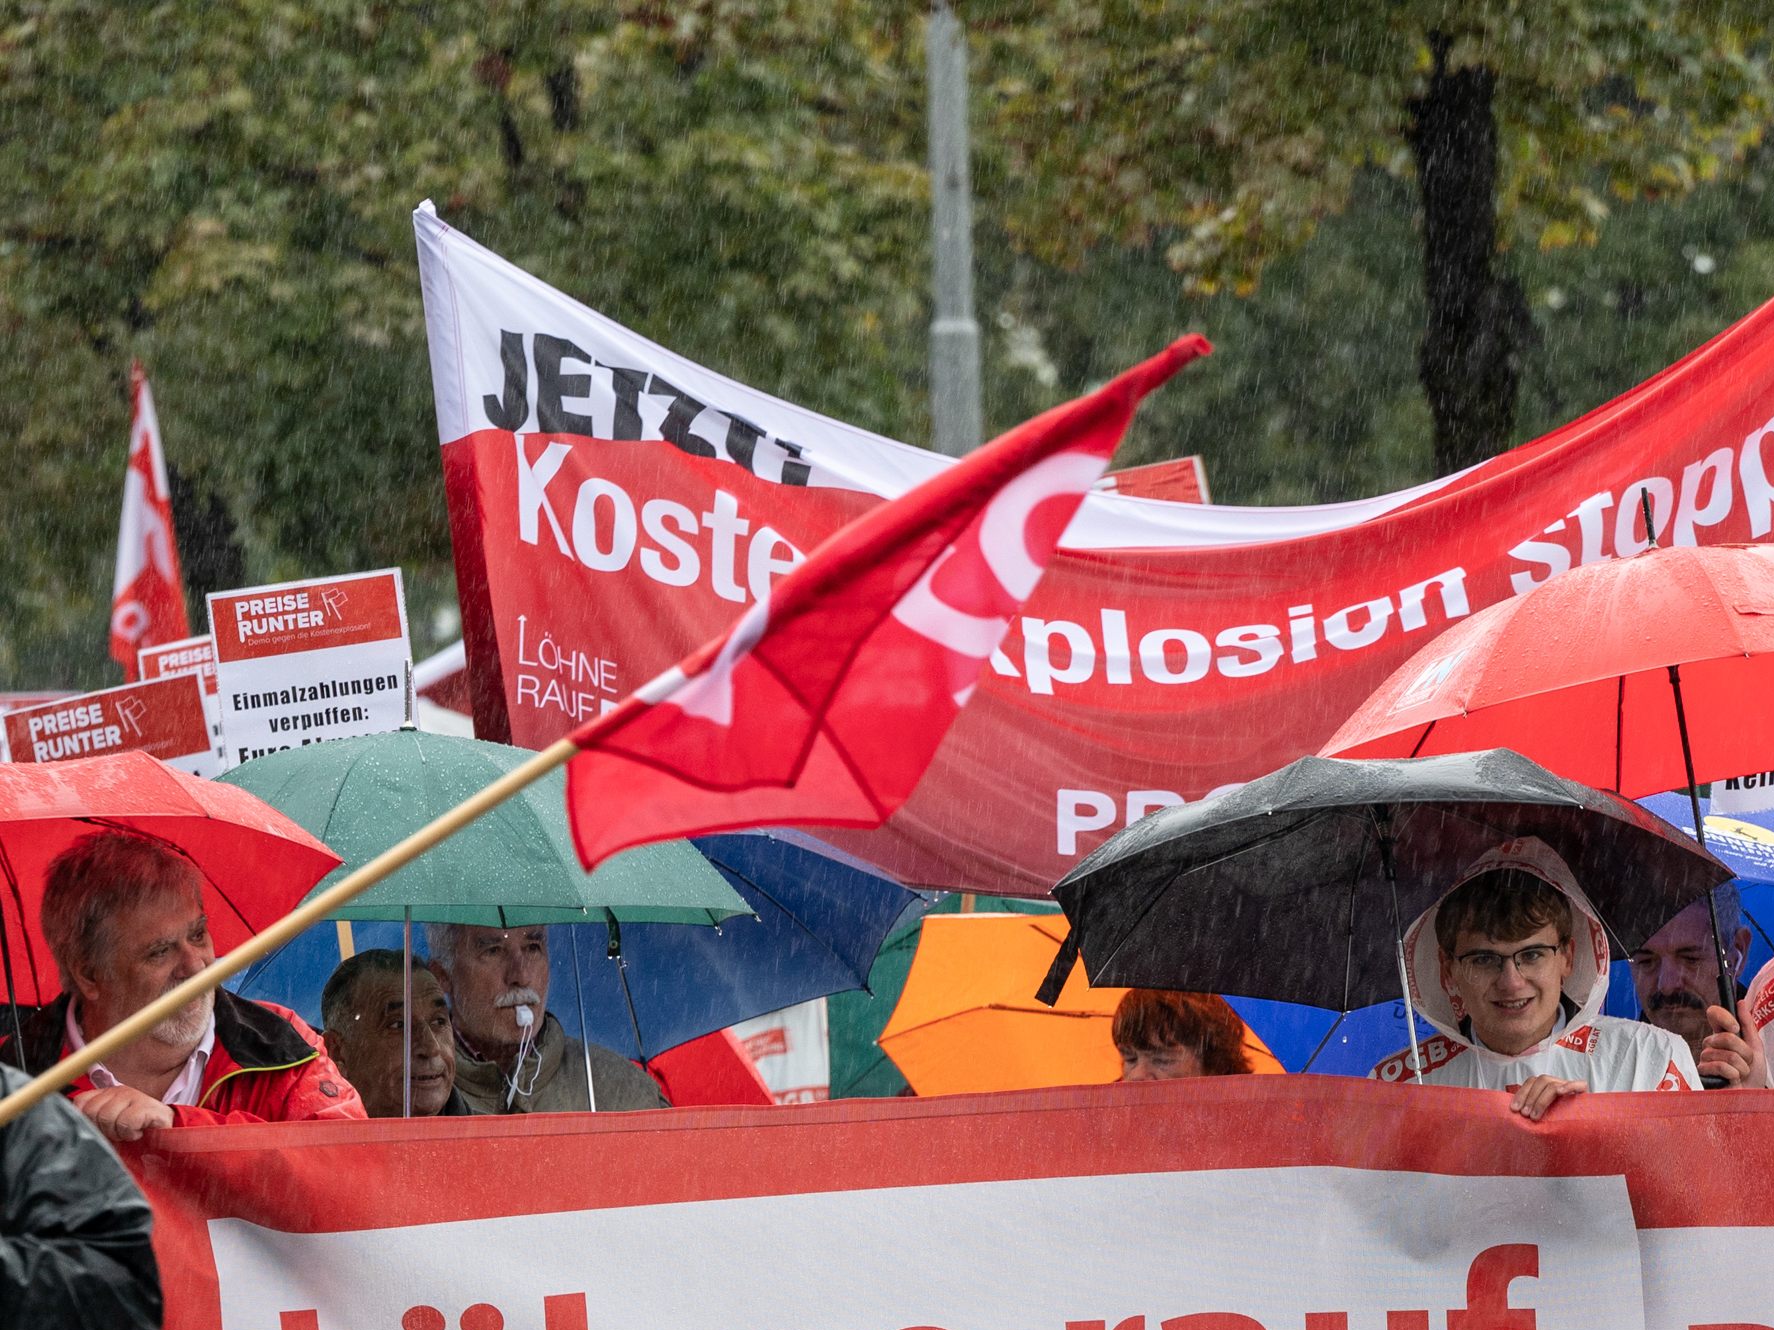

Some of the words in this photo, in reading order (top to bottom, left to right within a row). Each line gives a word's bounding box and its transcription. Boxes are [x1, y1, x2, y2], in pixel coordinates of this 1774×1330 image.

[235, 593, 309, 621] PREISE
[238, 611, 324, 643] RUNTER
[233, 674, 398, 711] Einmalzahlungen
[28, 703, 103, 743] PREISE
[269, 706, 369, 733] verpuffen:
[33, 725, 122, 763] RUNTER
